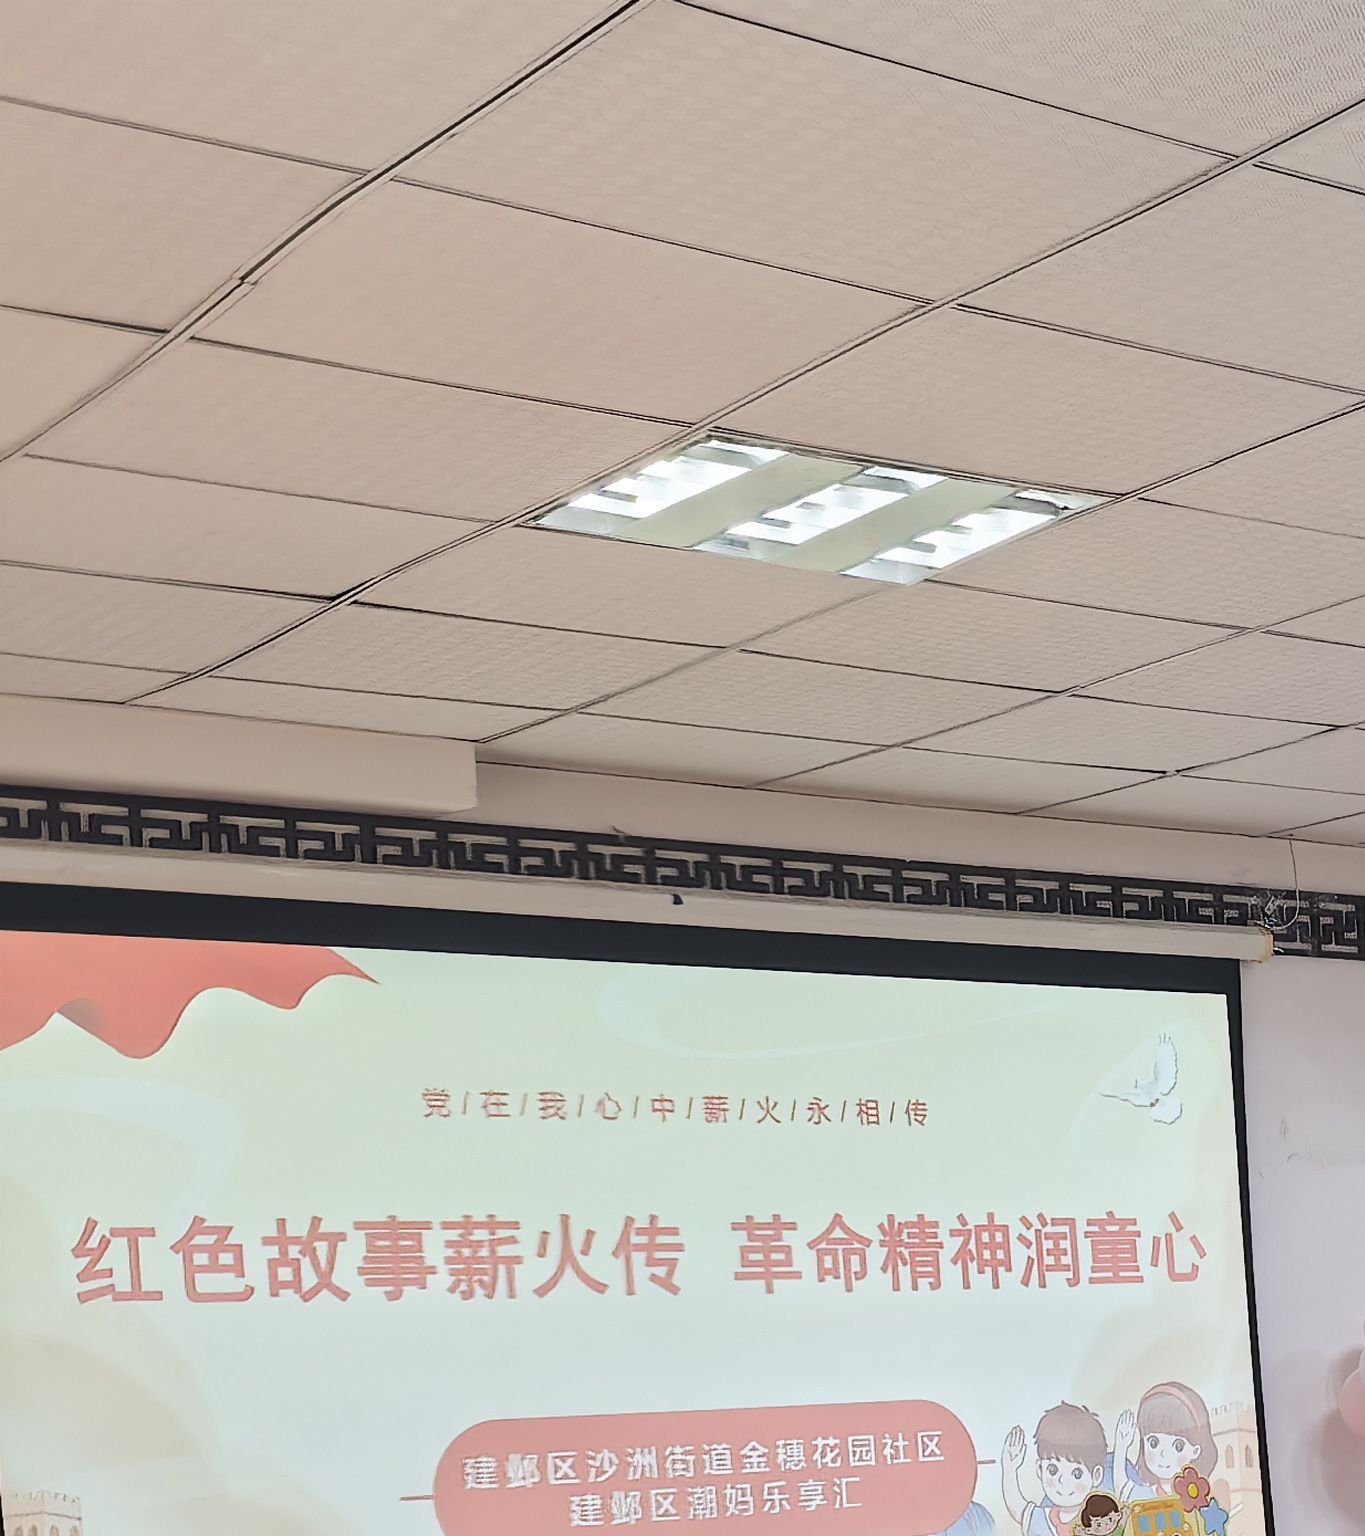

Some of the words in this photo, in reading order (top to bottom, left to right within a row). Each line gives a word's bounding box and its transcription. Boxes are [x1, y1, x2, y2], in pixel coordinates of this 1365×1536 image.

[70, 1212, 686, 1304] 红色故事薪火传
[730, 1210, 1208, 1295] 革命精神润童心
[461, 1430, 946, 1491] 建邺区沙洲街道金穗花园社区
[568, 1476, 863, 1529] 建邺区潮妈乐享汇
